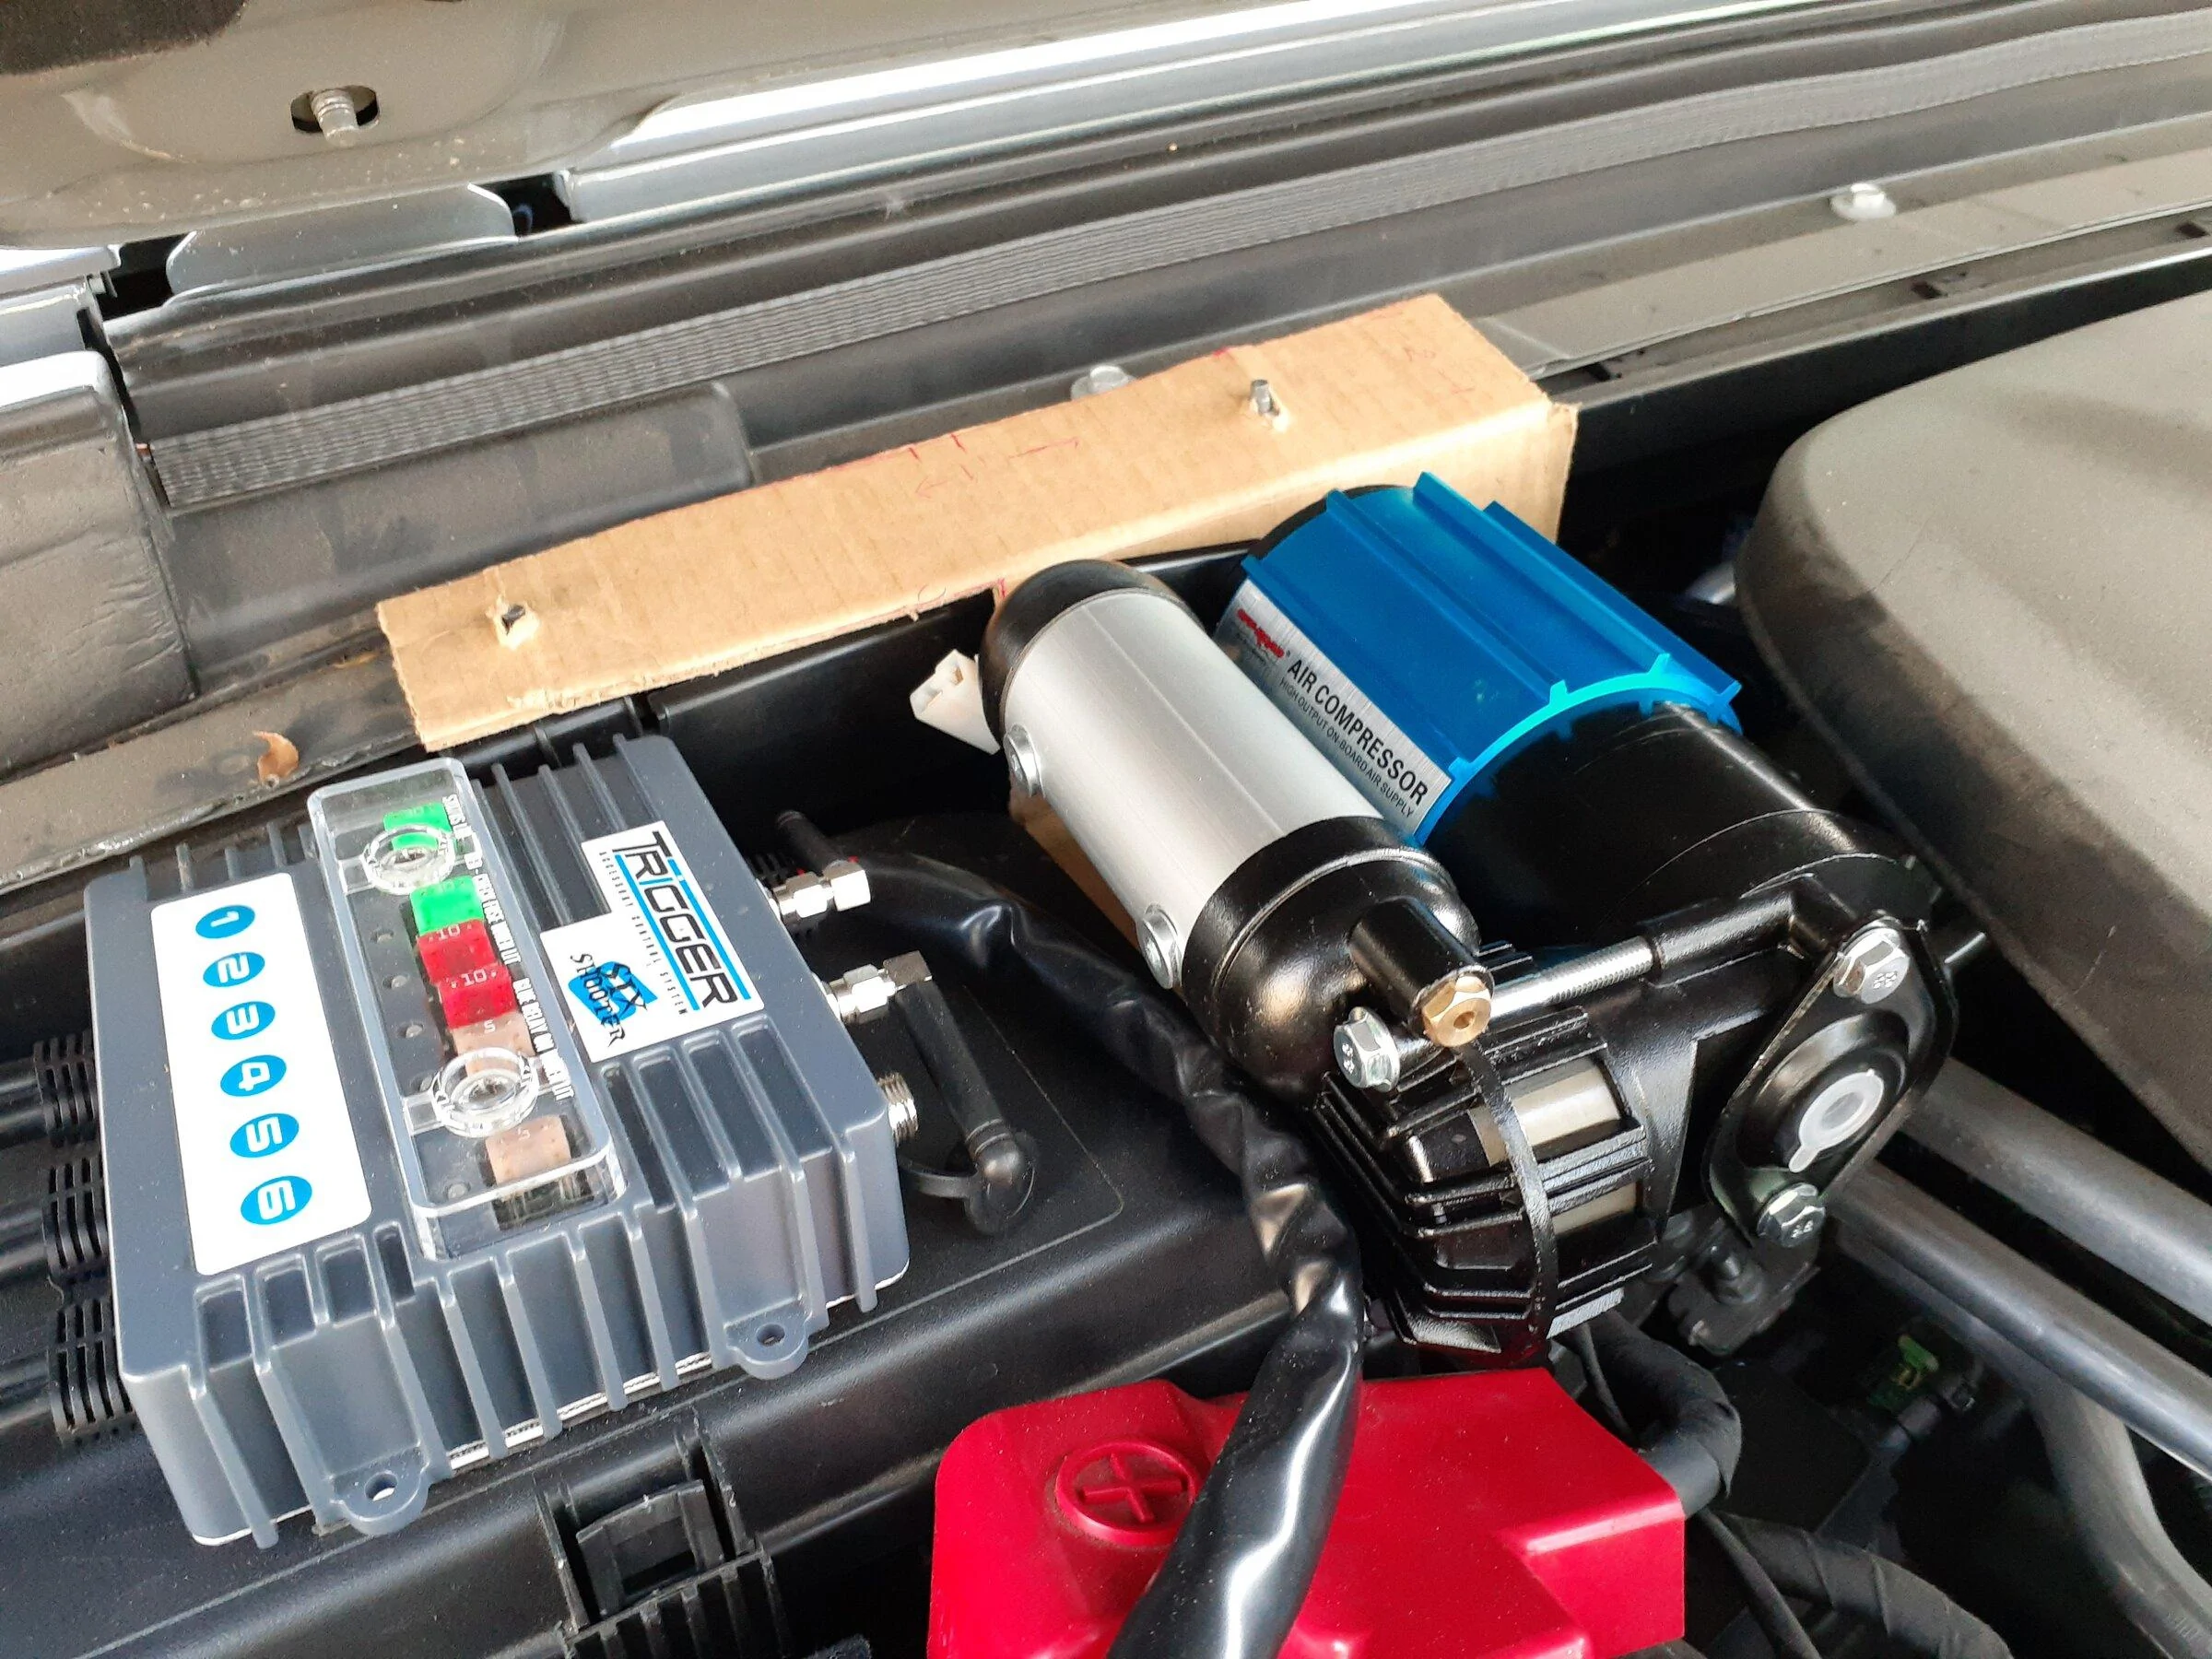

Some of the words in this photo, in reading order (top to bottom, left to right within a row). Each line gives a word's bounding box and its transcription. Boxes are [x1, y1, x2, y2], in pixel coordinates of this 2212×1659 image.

[1279, 677, 1299, 701] HIGH
[1298, 697, 1328, 729] OUTPUT
[1366, 768, 1382, 786] AIR
[1381, 782, 1415, 818] SUPPLY
[1288, 660, 1317, 693] AIR
[1315, 685, 1429, 806] COMPRESSOR
[210, 911, 239, 927] 1
[436, 925, 461, 941] 10
[218, 954, 250, 983] 2
[463, 968, 488, 986] 10
[660, 971, 688, 1015] SYSTEM
[226, 1005, 259, 1035] 3
[239, 1062, 270, 1091] 4
[246, 1116, 283, 1153] 5
[258, 1180, 296, 1220] 6
